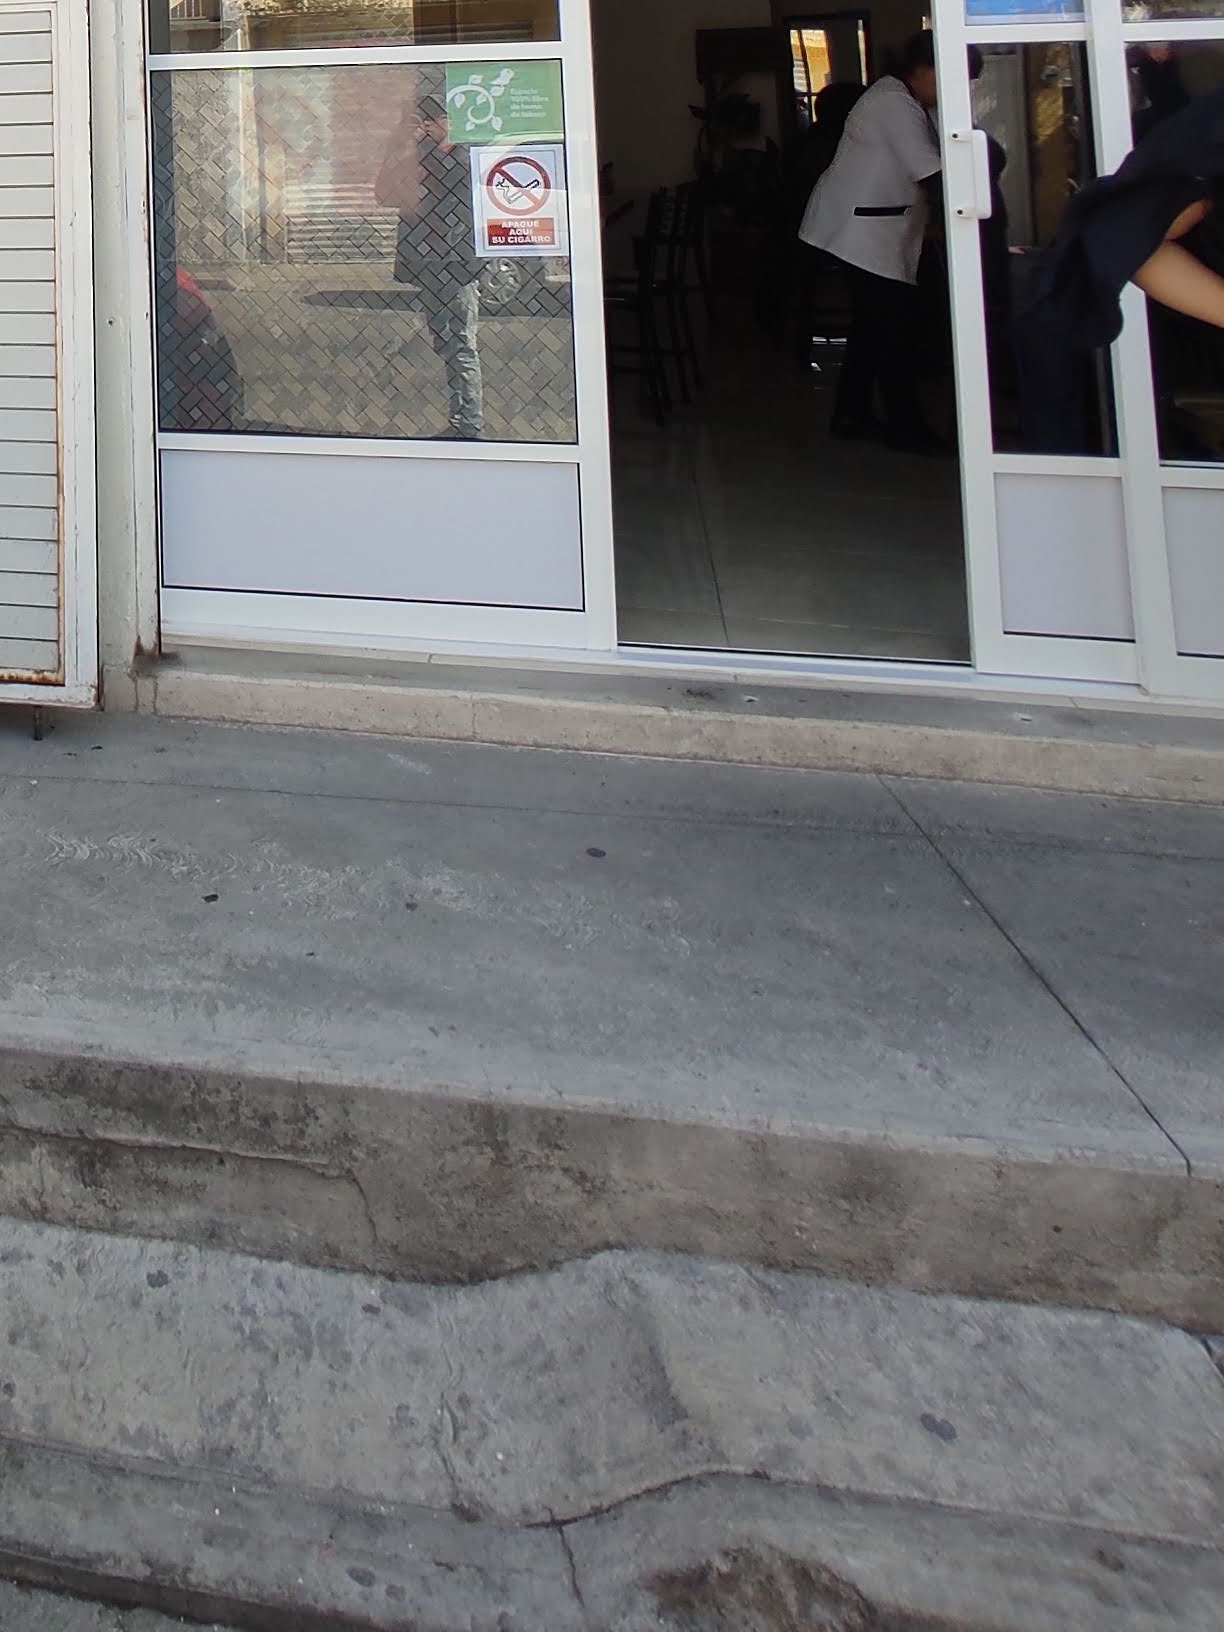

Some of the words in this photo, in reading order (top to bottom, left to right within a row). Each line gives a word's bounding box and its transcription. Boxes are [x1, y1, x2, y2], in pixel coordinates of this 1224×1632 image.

[509, 228, 533, 236] AQUI
[492, 236, 506, 244] SU
[507, 235, 552, 244] CIGARRO
